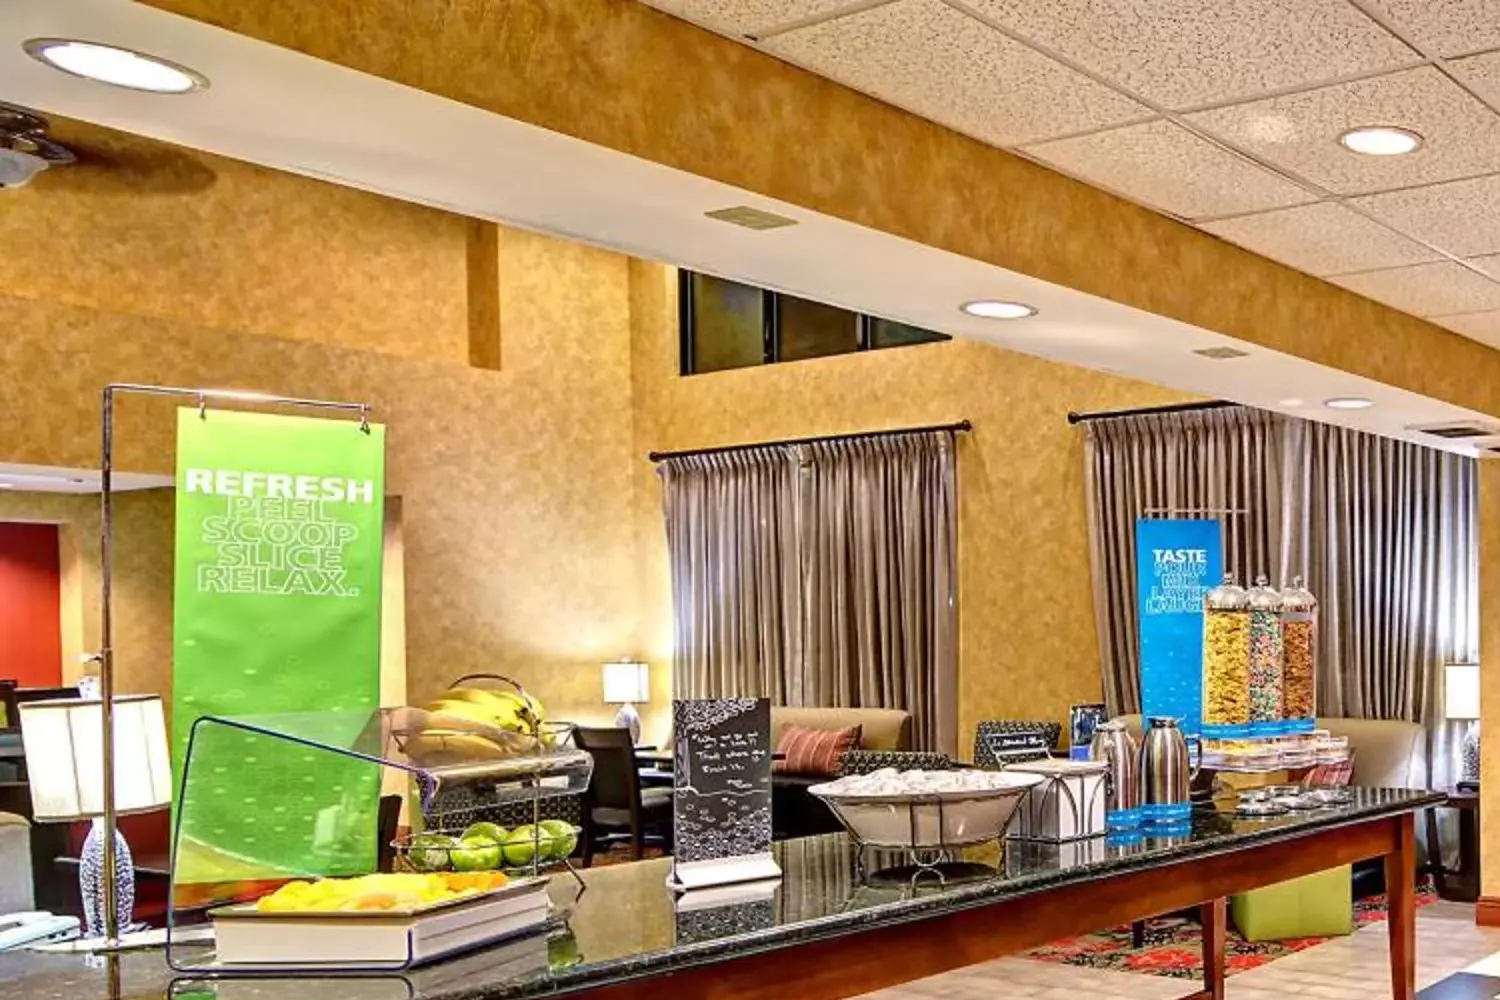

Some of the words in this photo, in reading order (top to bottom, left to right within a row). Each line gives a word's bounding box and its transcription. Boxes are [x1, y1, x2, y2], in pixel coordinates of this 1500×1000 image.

[185, 467, 373, 503] REFRESH
[227, 494, 335, 523] PEEL
[202, 514, 359, 548] SCOOP
[217, 541, 346, 571] SLICE
[1151, 548, 1209, 563] TASTE
[197, 564, 360, 596] RELAX.
